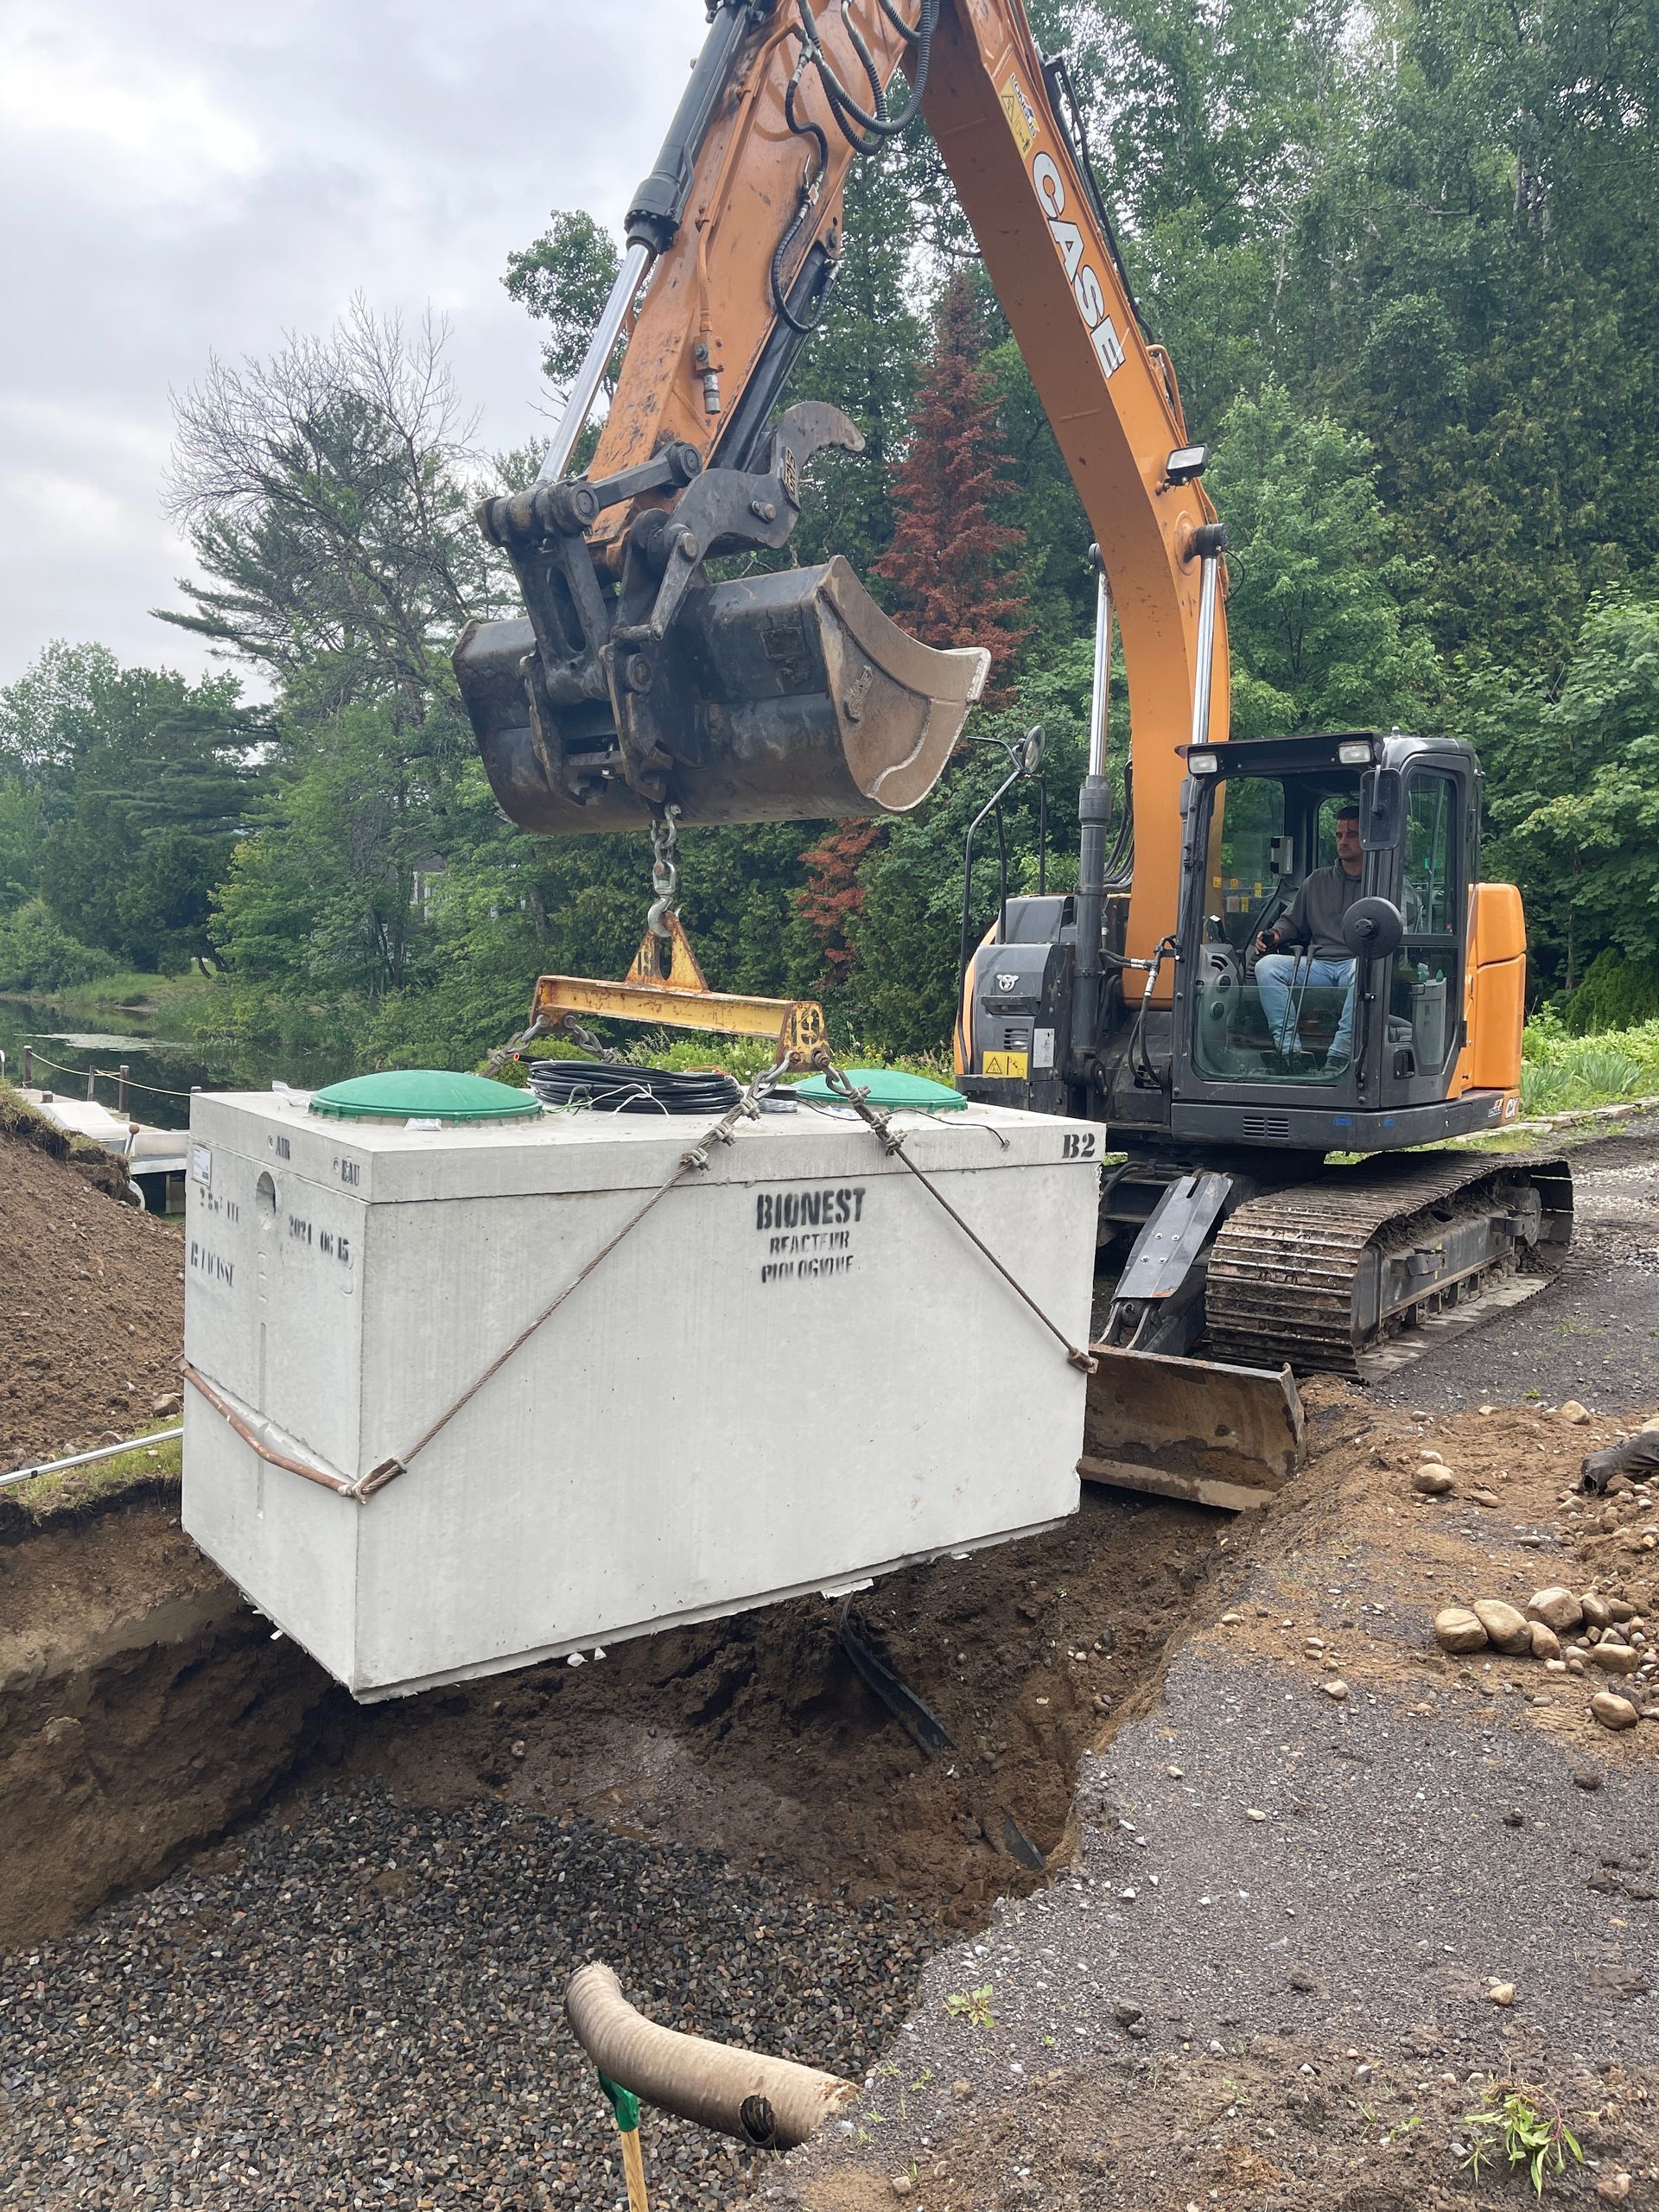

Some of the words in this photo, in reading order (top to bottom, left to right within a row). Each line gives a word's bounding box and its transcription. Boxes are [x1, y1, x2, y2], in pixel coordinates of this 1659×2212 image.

[1033, 151, 1126, 379] CASE
[276, 1135, 290, 1161] AIR
[1062, 1133, 1095, 1159] B2
[341, 1159, 360, 1186] EAU
[756, 1187, 866, 1230] BIONEST
